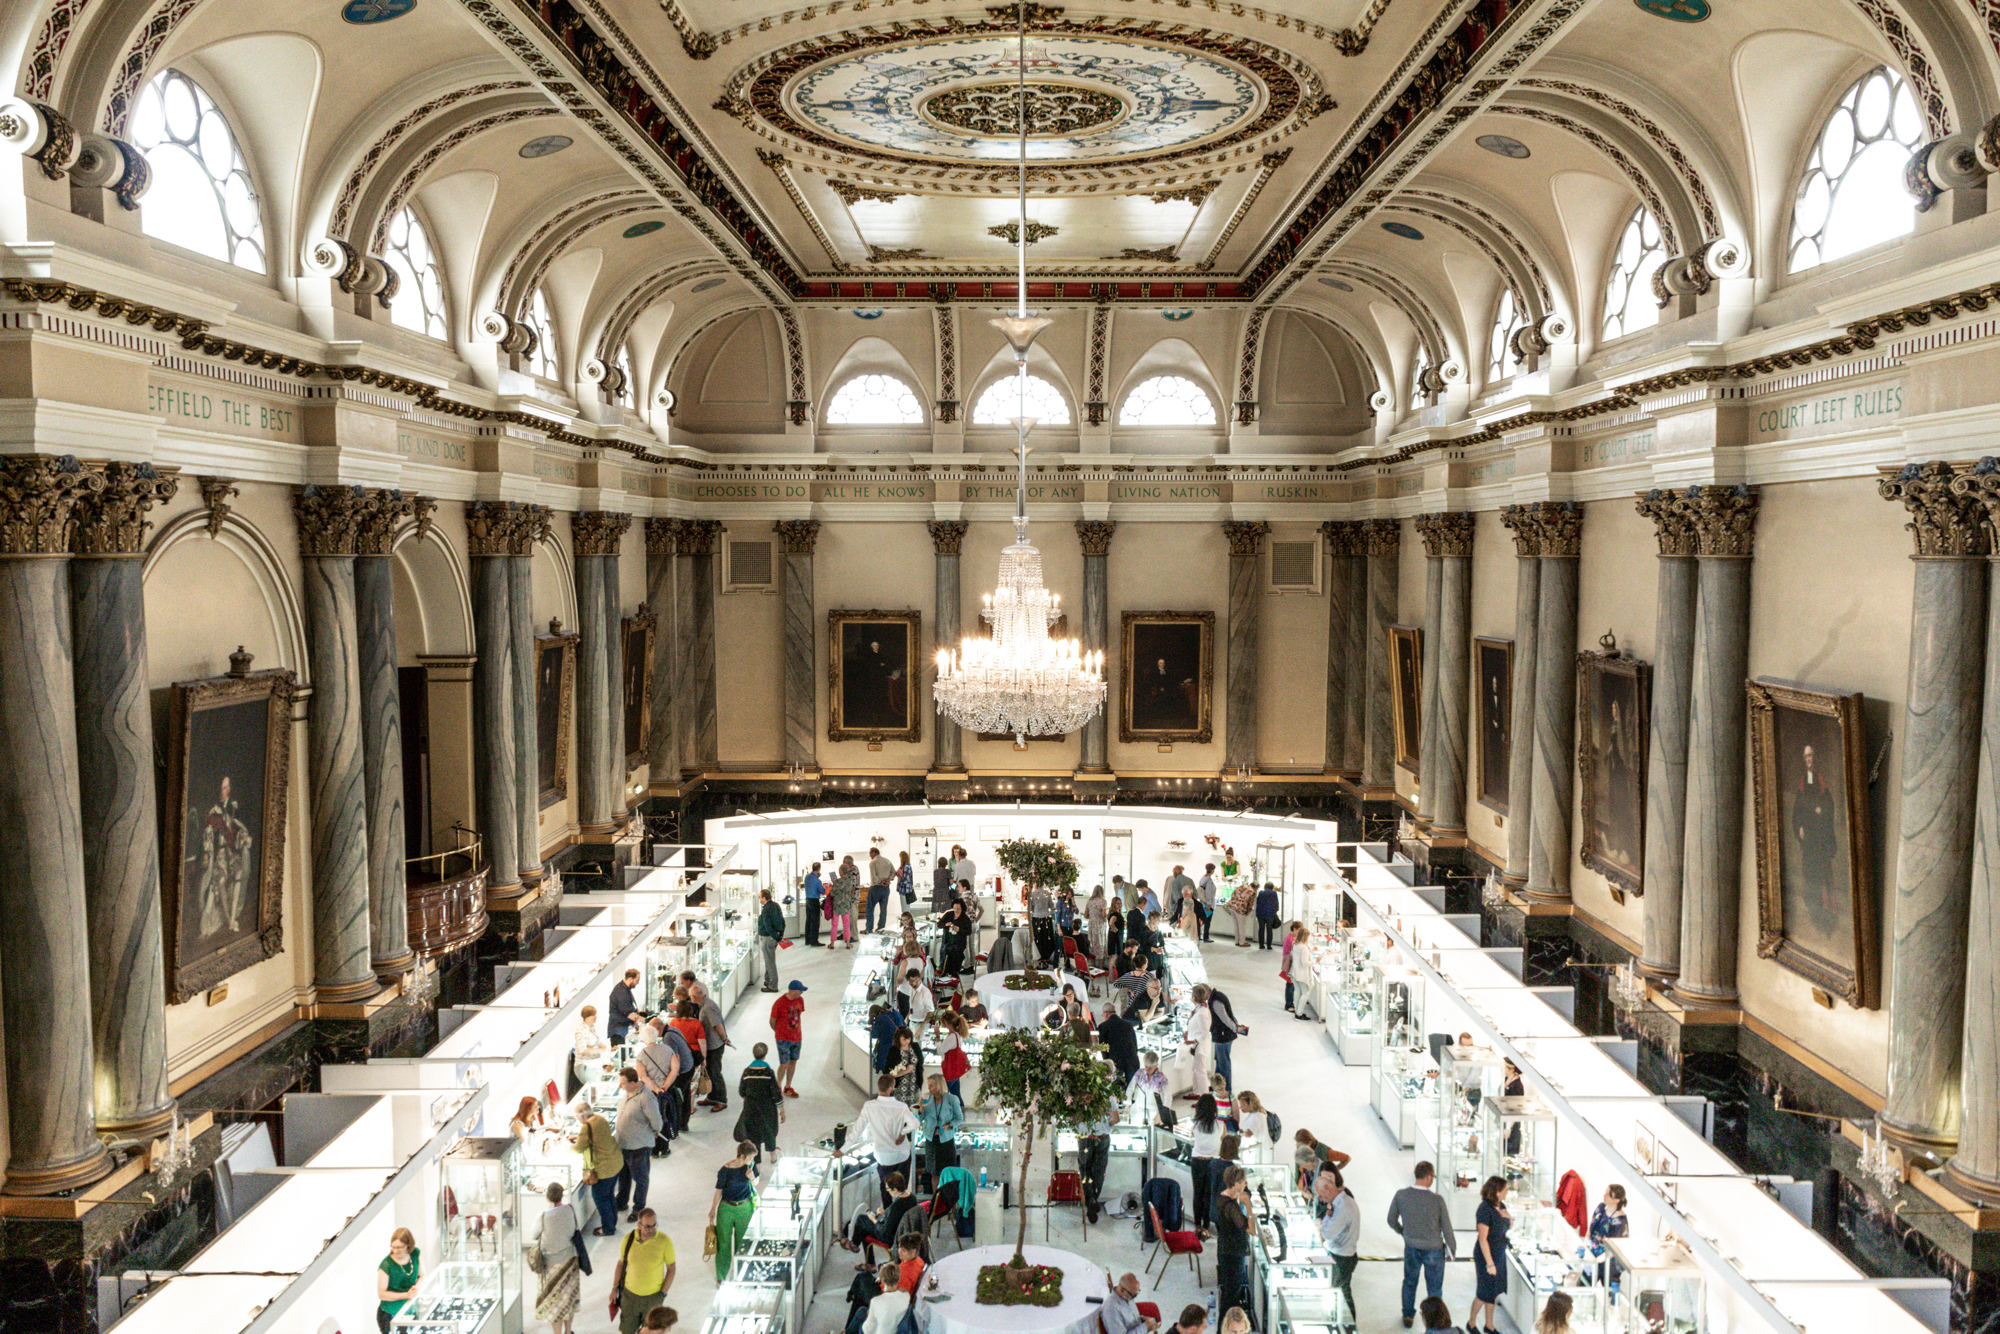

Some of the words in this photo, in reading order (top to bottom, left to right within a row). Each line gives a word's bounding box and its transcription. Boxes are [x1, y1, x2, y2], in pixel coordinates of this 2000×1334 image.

[222, 399, 251, 426] THE
[260, 406, 293, 432] BEST
[1758, 404, 1808, 432] COURT
[1814, 397, 1847, 424] LEET
[1853, 387, 1902, 418] RULES
[416, 437, 439, 458] KIND
[443, 442, 466, 462] DONE
[1583, 445, 1595, 463] BY
[1598, 438, 1628, 460] COURT
[1632, 433, 1652, 454] LEET
[697, 486, 757, 497] CHOOSES
[762, 486, 781, 497] TO
[785, 486, 806, 497] DO
[823, 487, 846, 498] ALL
[854, 487, 870, 498] HE
[878, 487, 925, 498] KNOWS
[966, 487, 981, 498] BY
[1028, 487, 1045, 498] OF
[1051, 487, 1079, 498] ANY
[1117, 487, 1161, 498] LIVING
